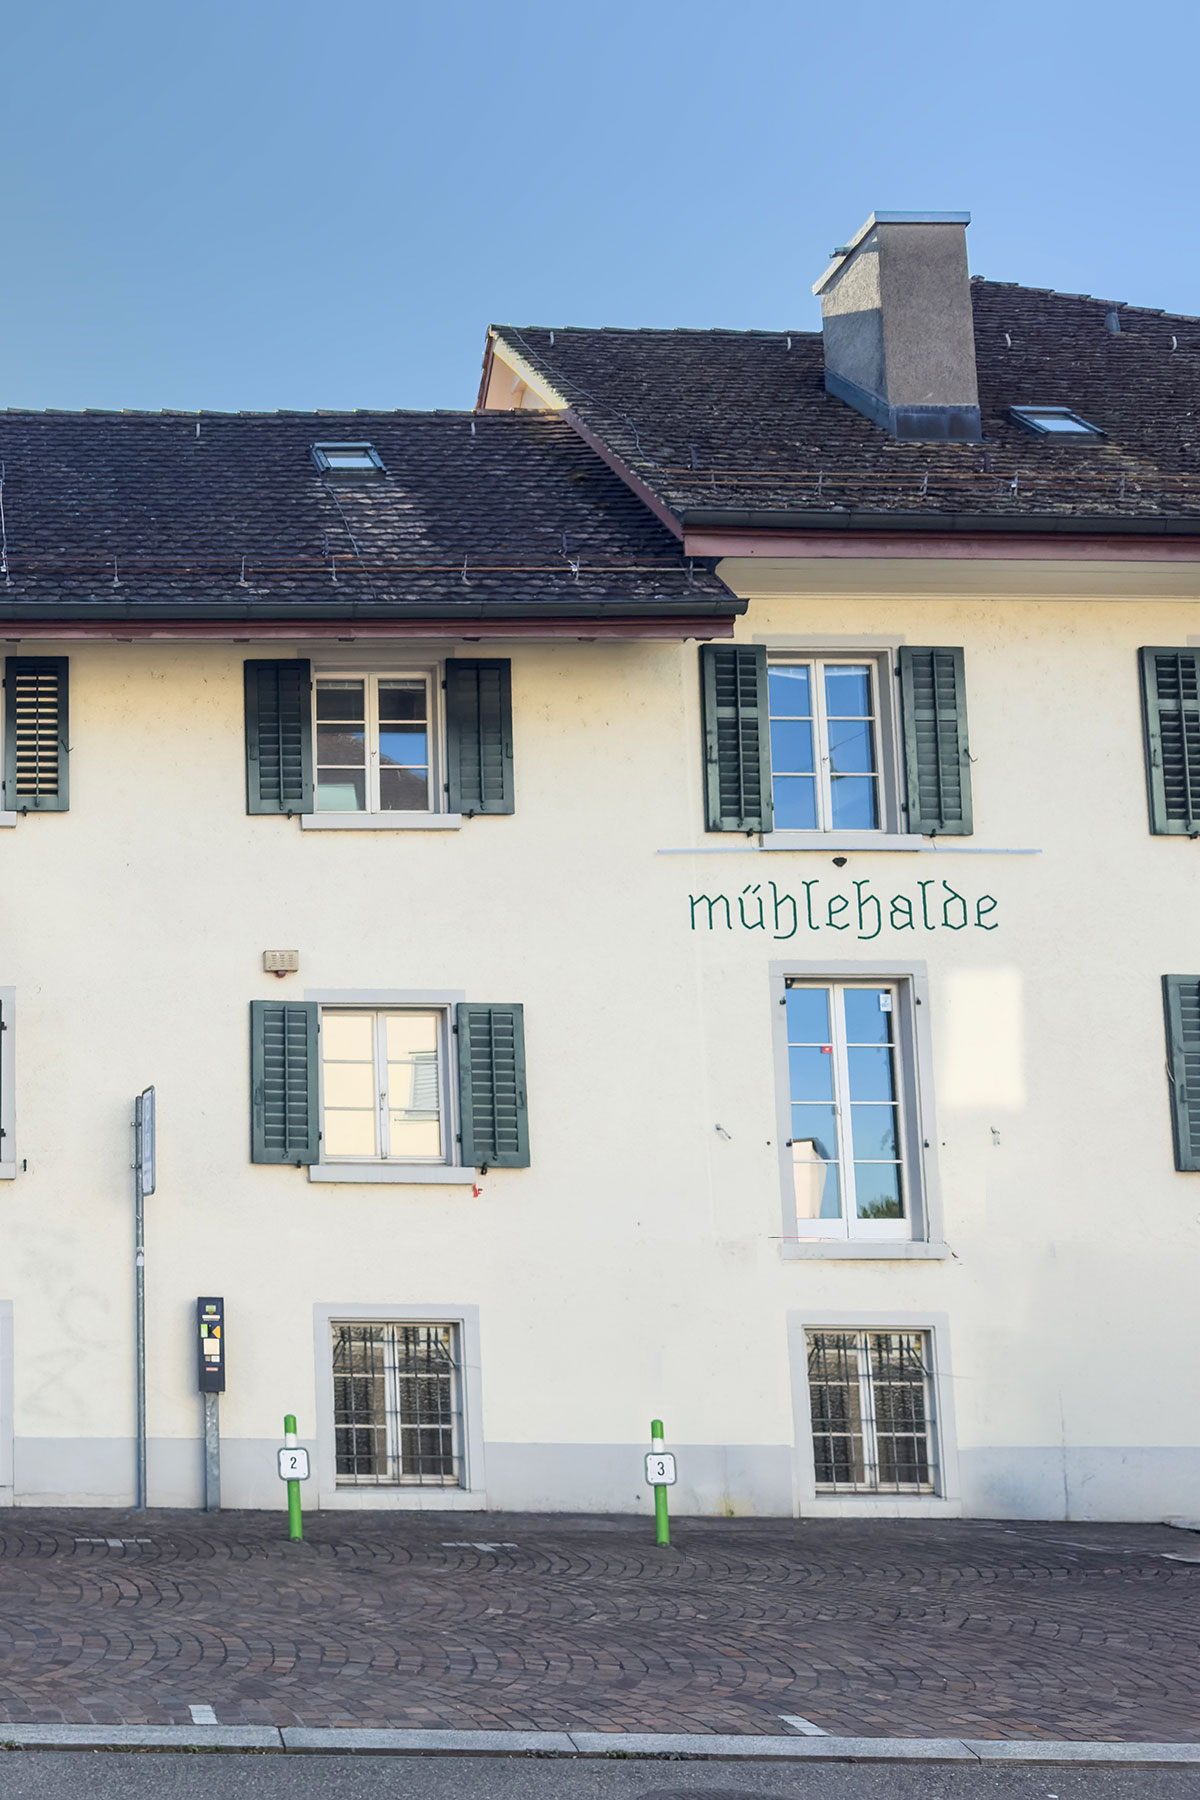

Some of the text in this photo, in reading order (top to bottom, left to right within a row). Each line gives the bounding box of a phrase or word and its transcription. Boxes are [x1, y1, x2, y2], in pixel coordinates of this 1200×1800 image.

[688, 879, 999, 939] mühlehalde
[290, 1456, 297, 1469] 2
[657, 1461, 665, 1476] 3
